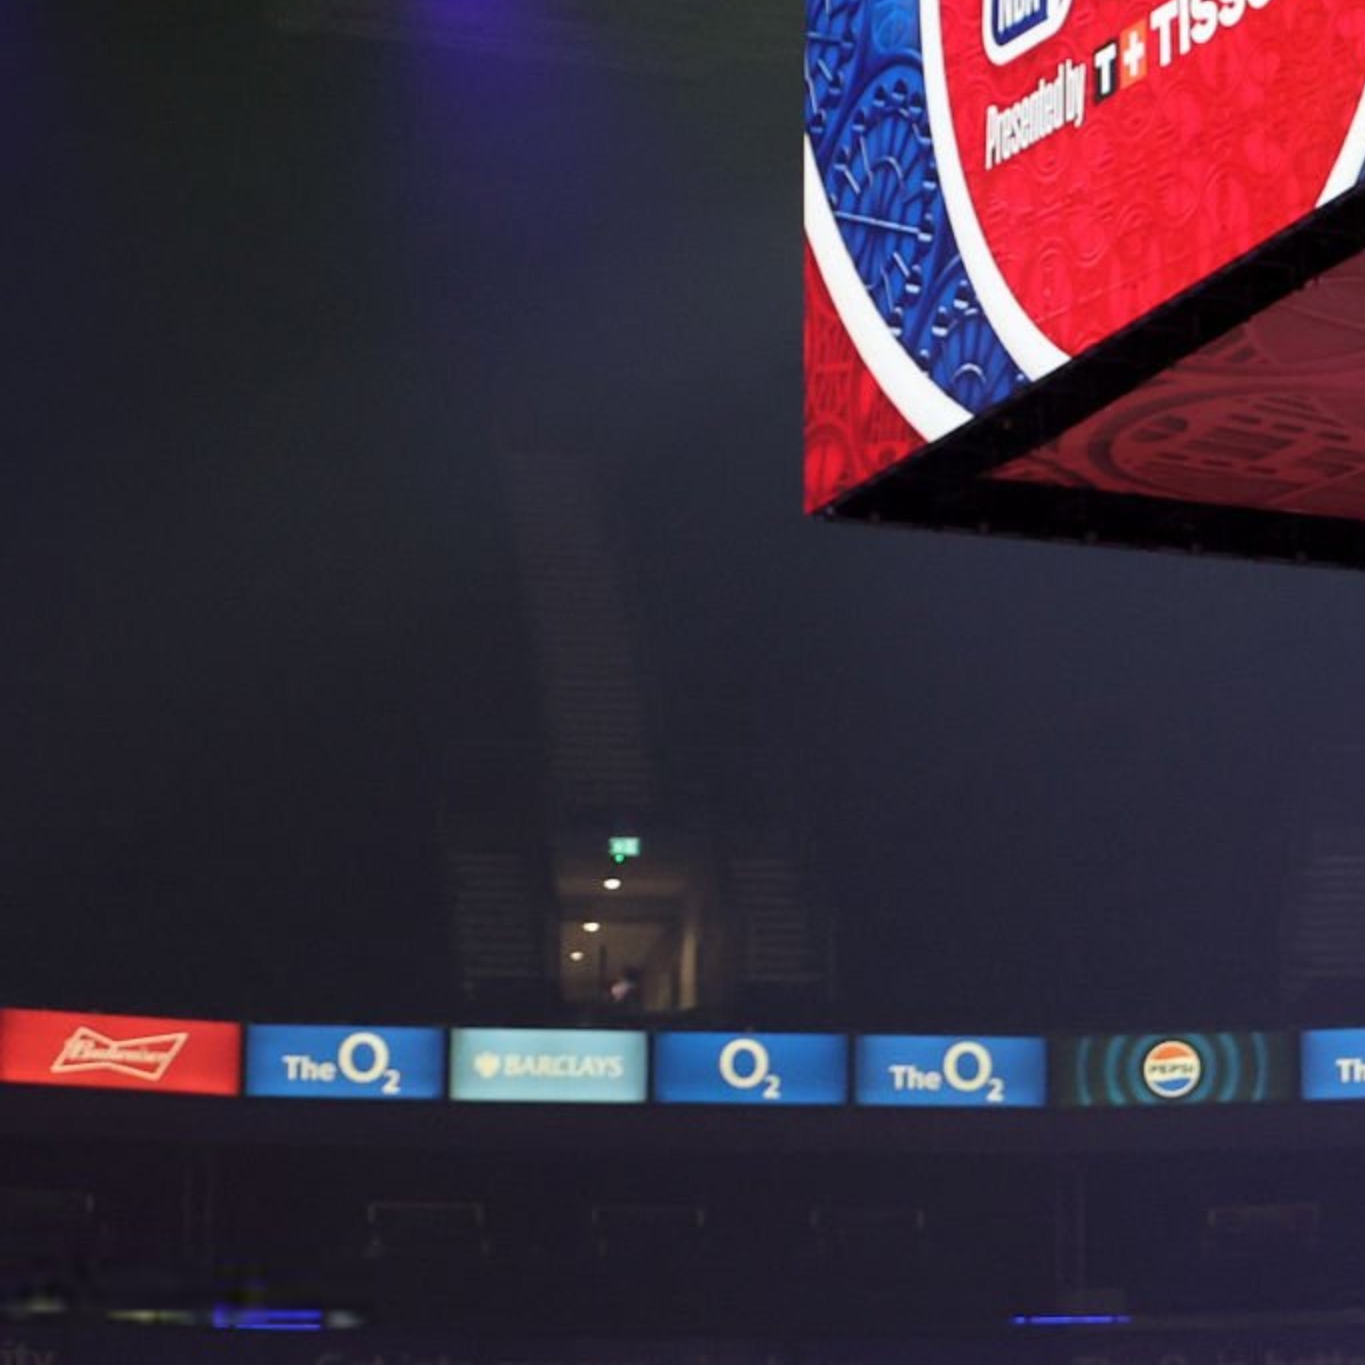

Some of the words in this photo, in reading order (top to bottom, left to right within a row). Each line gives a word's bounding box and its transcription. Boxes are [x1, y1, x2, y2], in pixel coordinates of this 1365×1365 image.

[985, 67, 1067, 170] Presented
[1066, 59, 1087, 128] by
[281, 1053, 337, 1082] The
[504, 1052, 624, 1079] BARCLAYS
[888, 1064, 941, 1092] The
